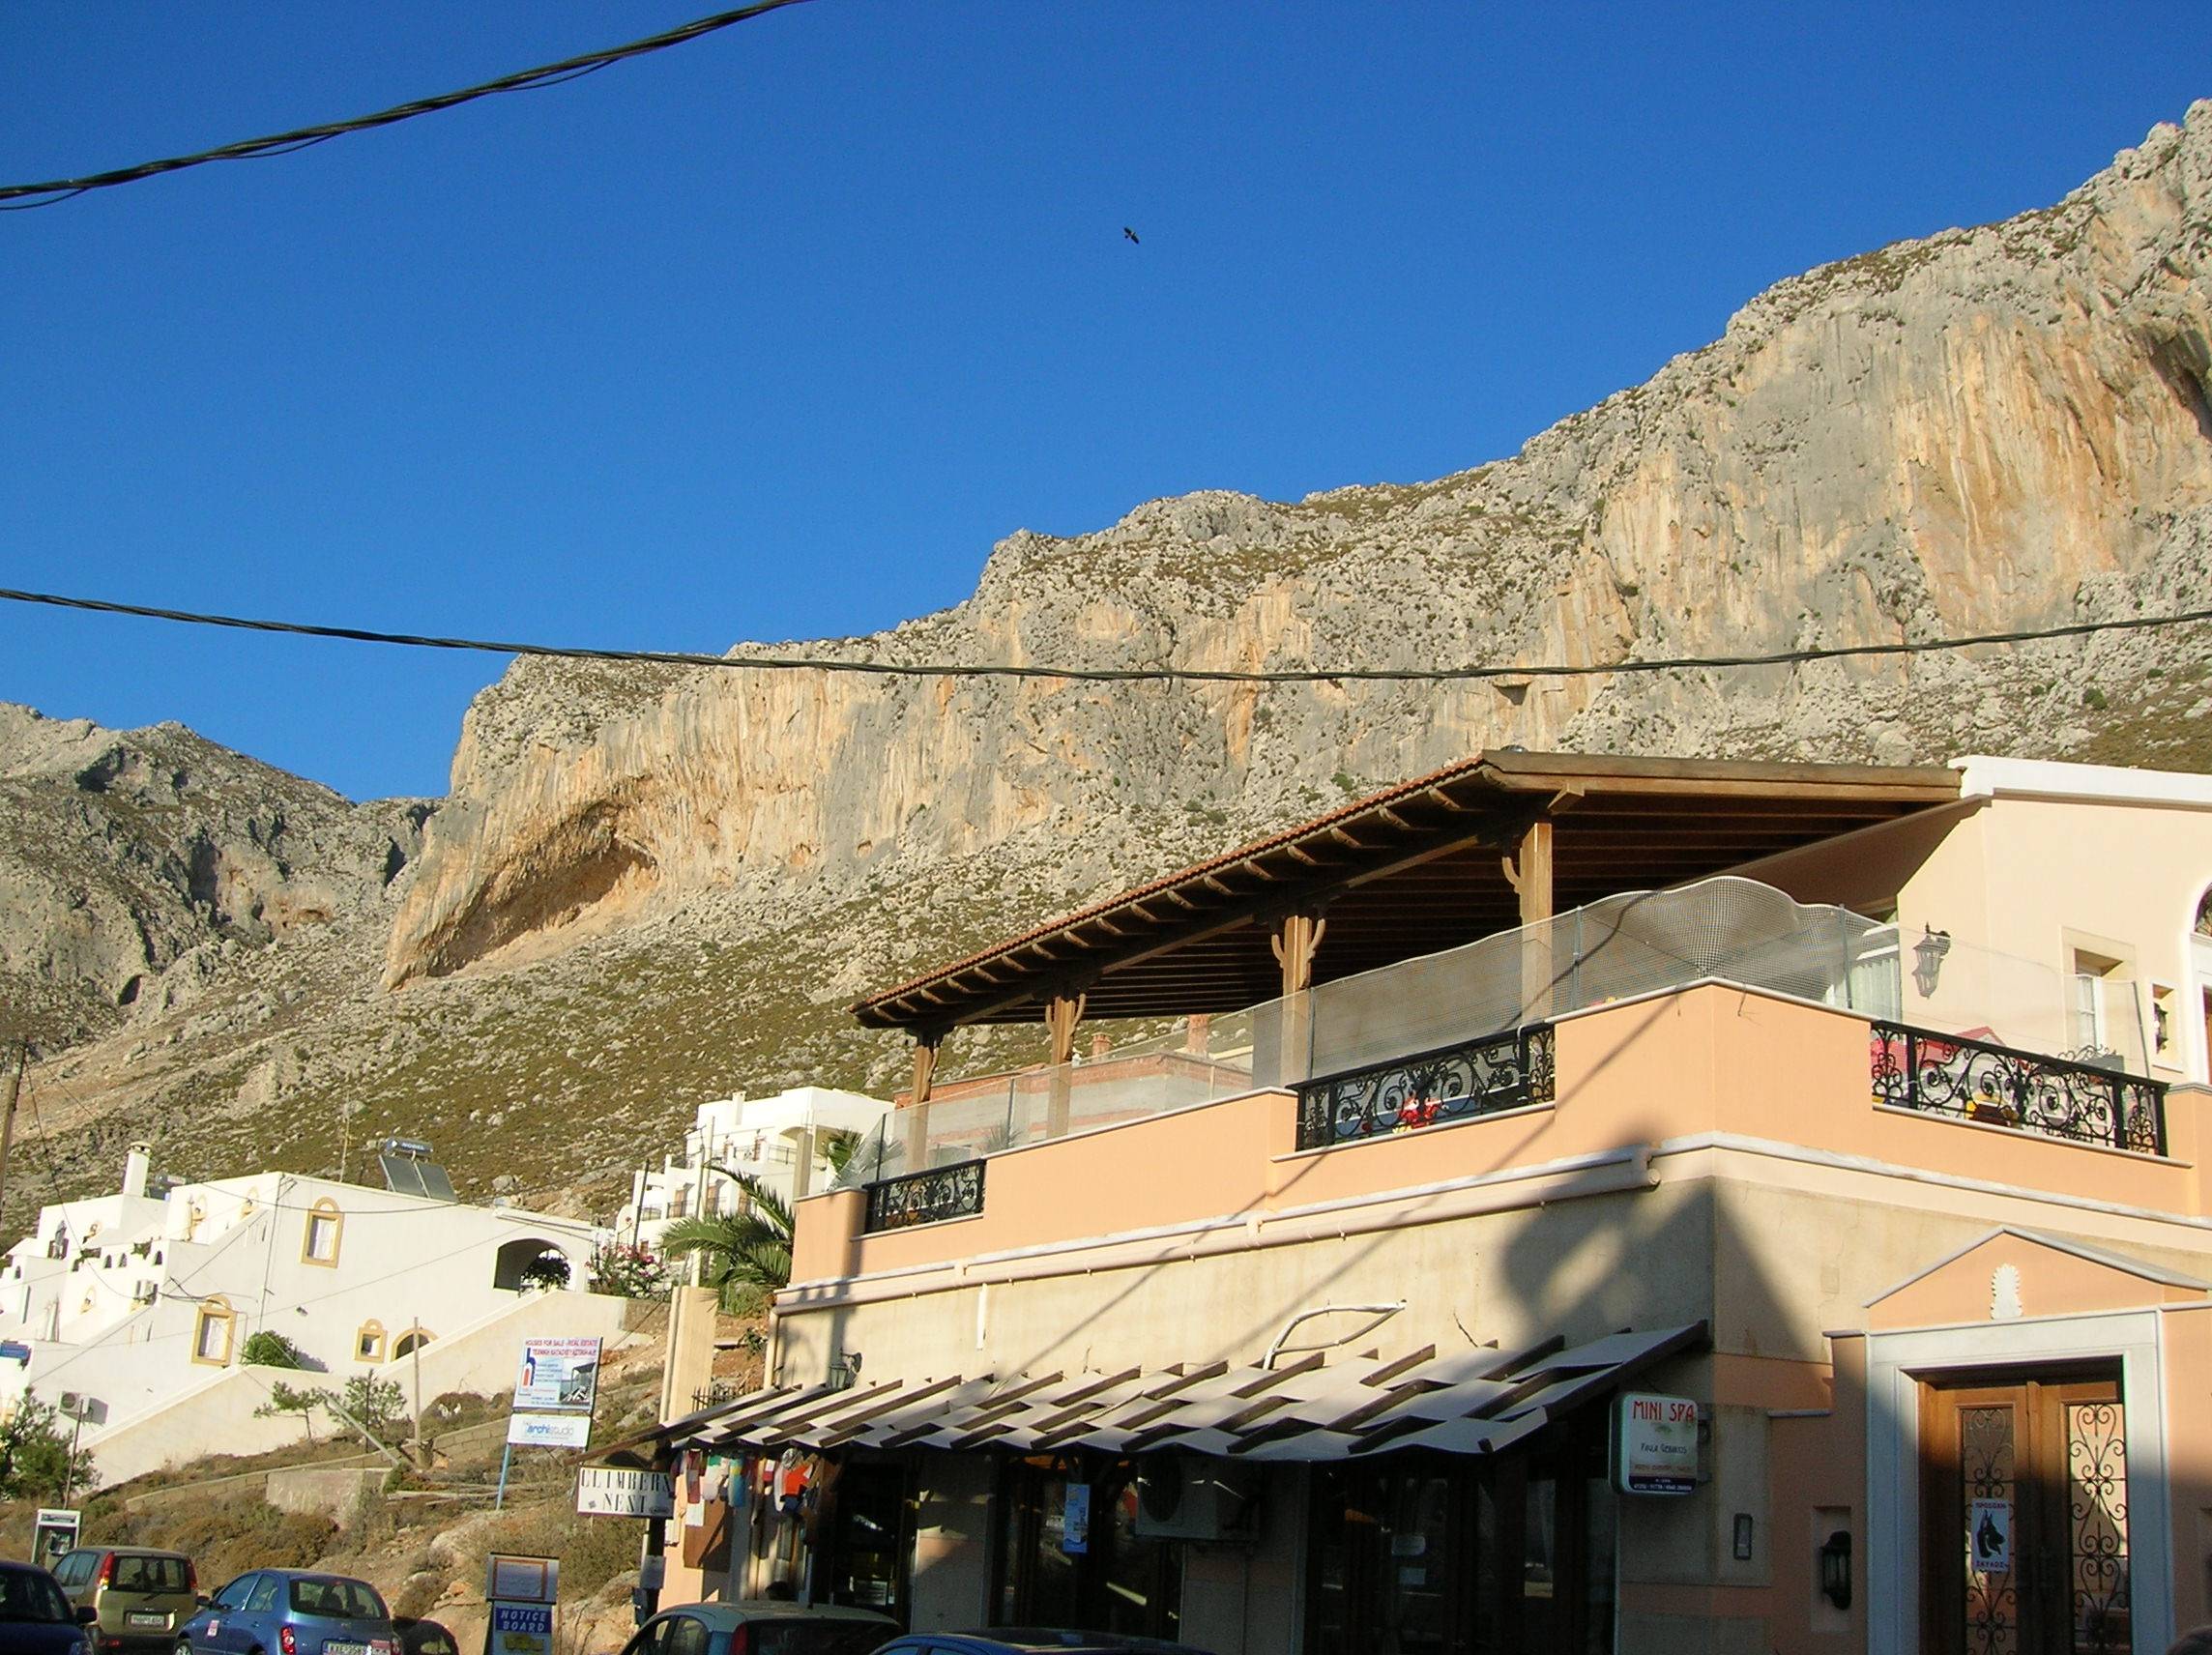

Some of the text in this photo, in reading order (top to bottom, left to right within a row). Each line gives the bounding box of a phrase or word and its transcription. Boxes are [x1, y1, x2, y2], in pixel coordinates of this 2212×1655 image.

[1633, 1401, 1695, 1422] MINI SPA
[581, 1469, 671, 1492] CLIMBERS
[603, 1493, 647, 1513] NEST
[501, 1610, 547, 1623] NOTICE
[503, 1621, 545, 1633] BOARD
